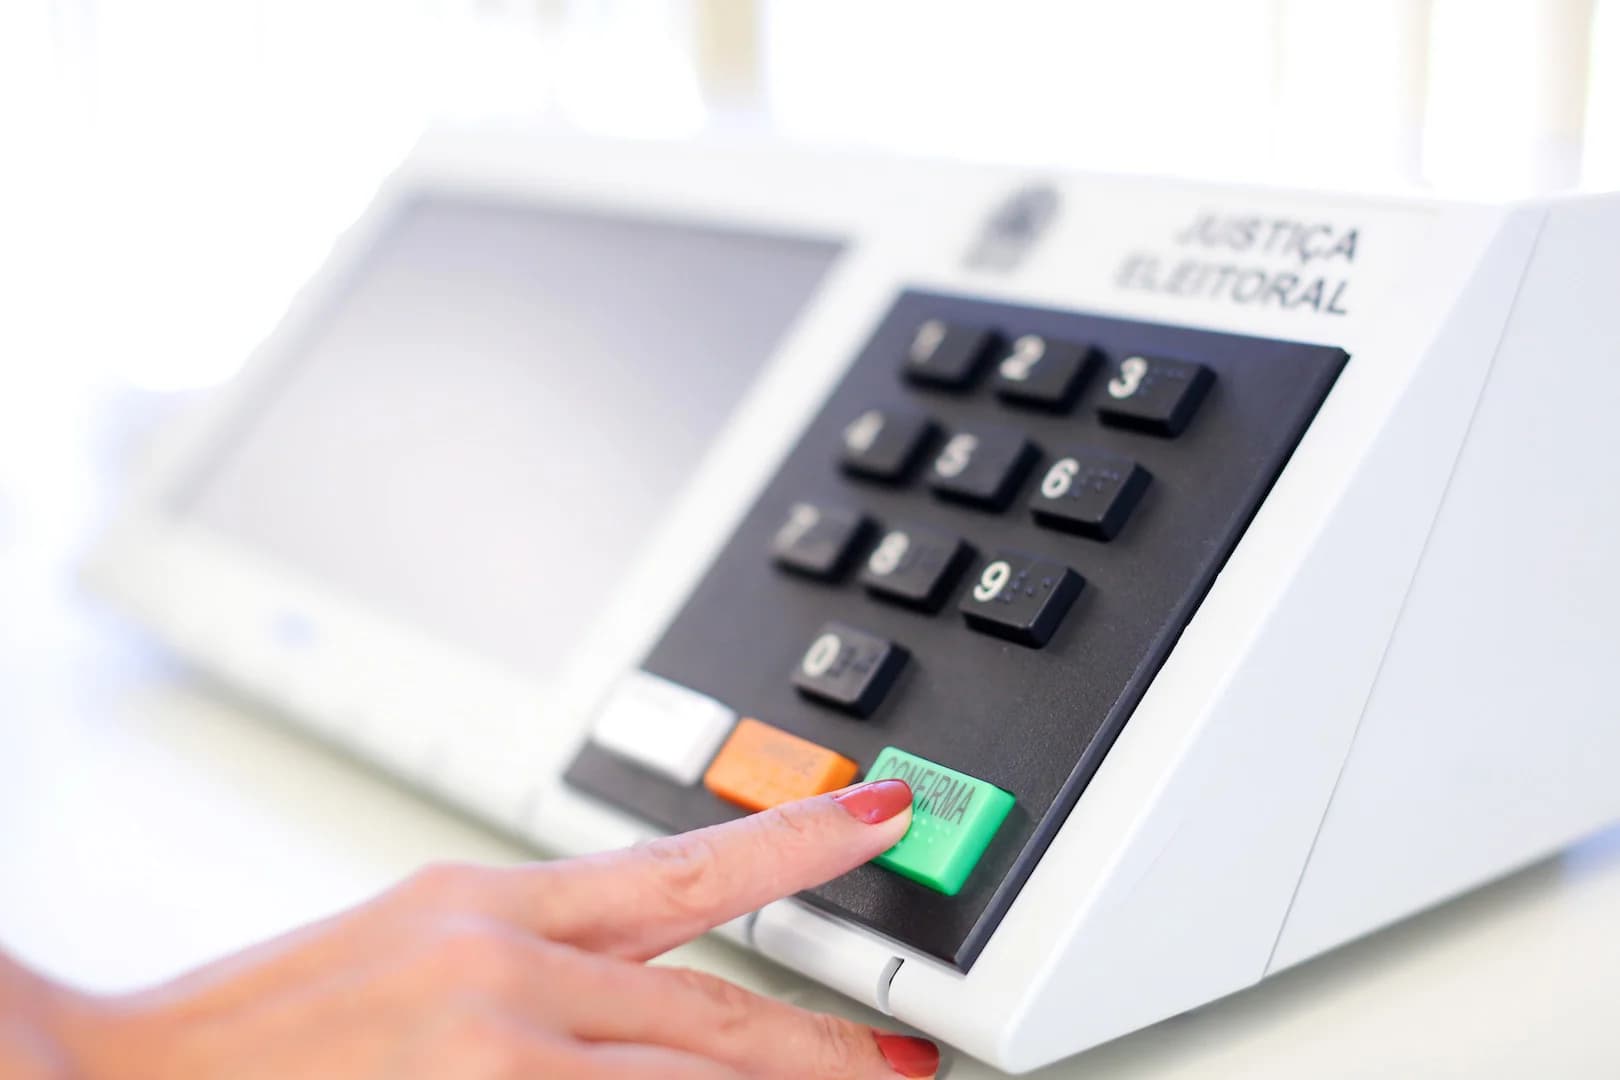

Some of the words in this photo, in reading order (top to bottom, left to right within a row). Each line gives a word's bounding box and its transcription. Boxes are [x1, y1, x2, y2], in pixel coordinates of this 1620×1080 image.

[1174, 212, 1361, 265] JUSTIÇA
[1115, 250, 1350, 316] ELEITORAL
[1000, 335, 1045, 380] 2
[1108, 357, 1147, 398] 3
[935, 433, 978, 477] 5
[1041, 457, 1080, 498] 6
[868, 531, 908, 574] 8
[973, 561, 1010, 601] 9
[802, 634, 840, 676] 0
